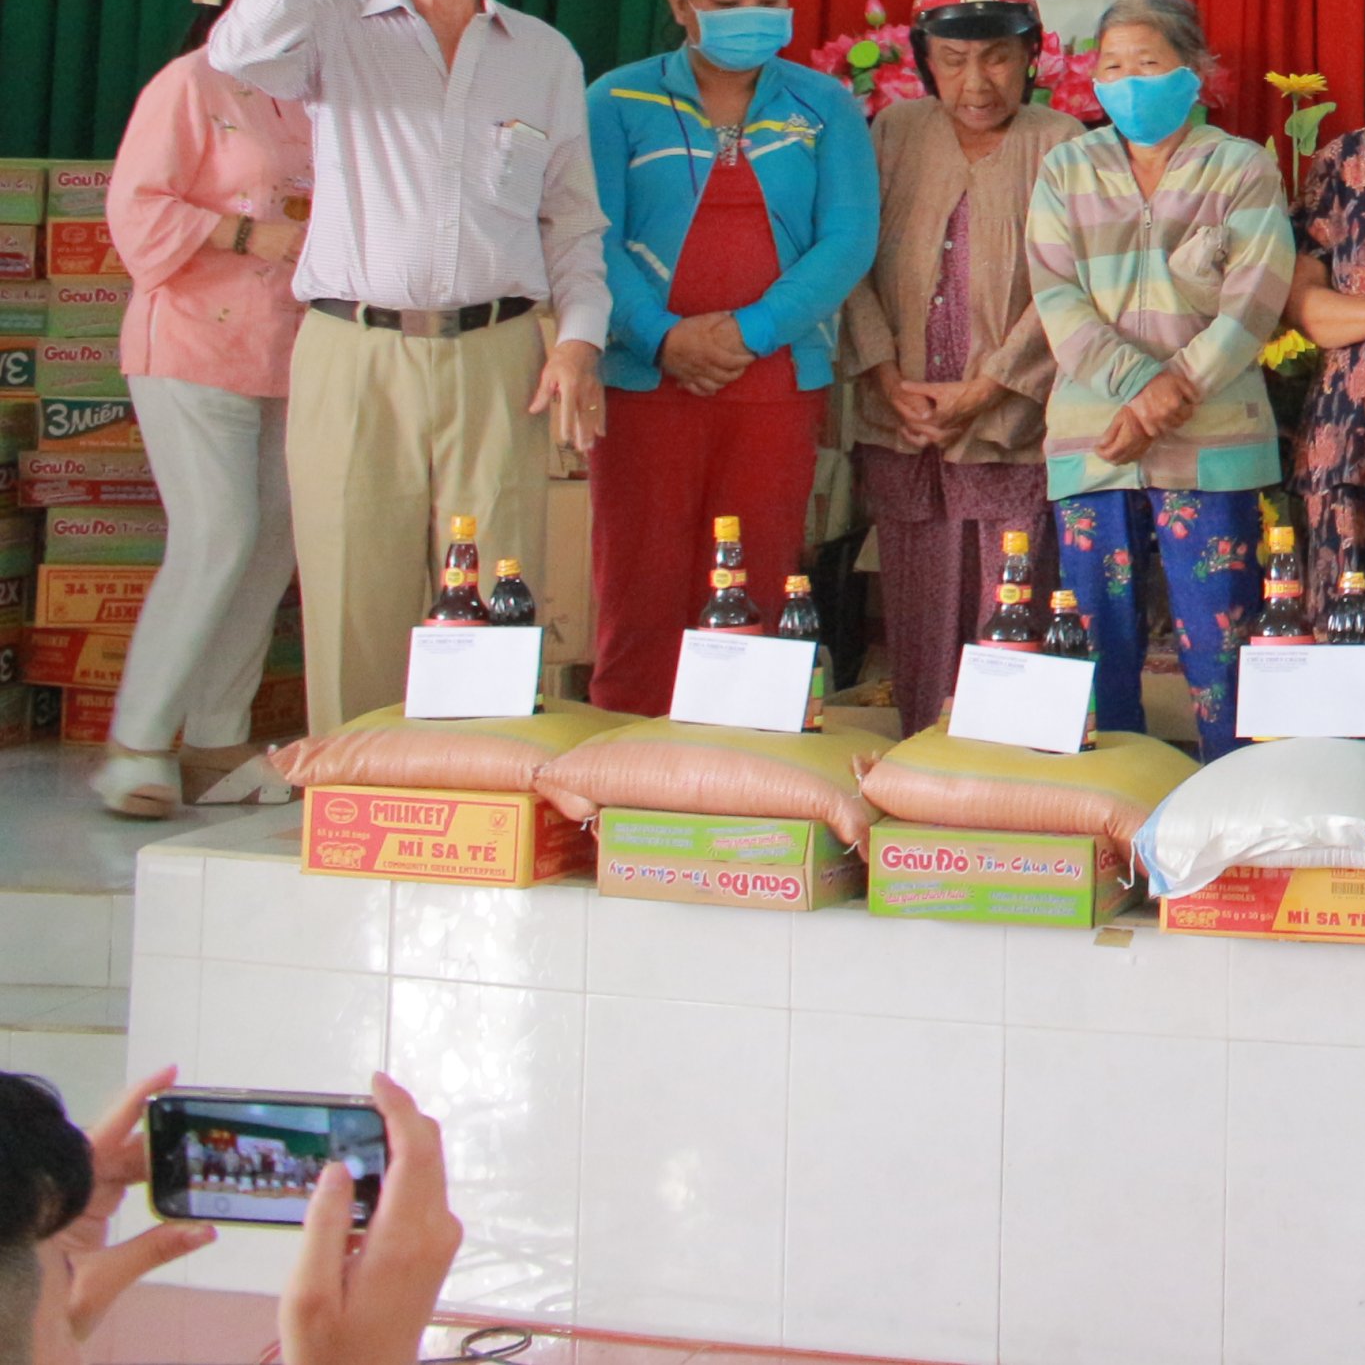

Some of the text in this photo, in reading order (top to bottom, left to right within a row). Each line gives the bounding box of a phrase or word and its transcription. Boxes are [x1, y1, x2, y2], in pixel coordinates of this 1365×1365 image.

[47, 403, 71, 436] 3
[371, 801, 449, 827] MILIKET
[431, 842, 460, 860] SA
[1316, 912, 1340, 926] SA
